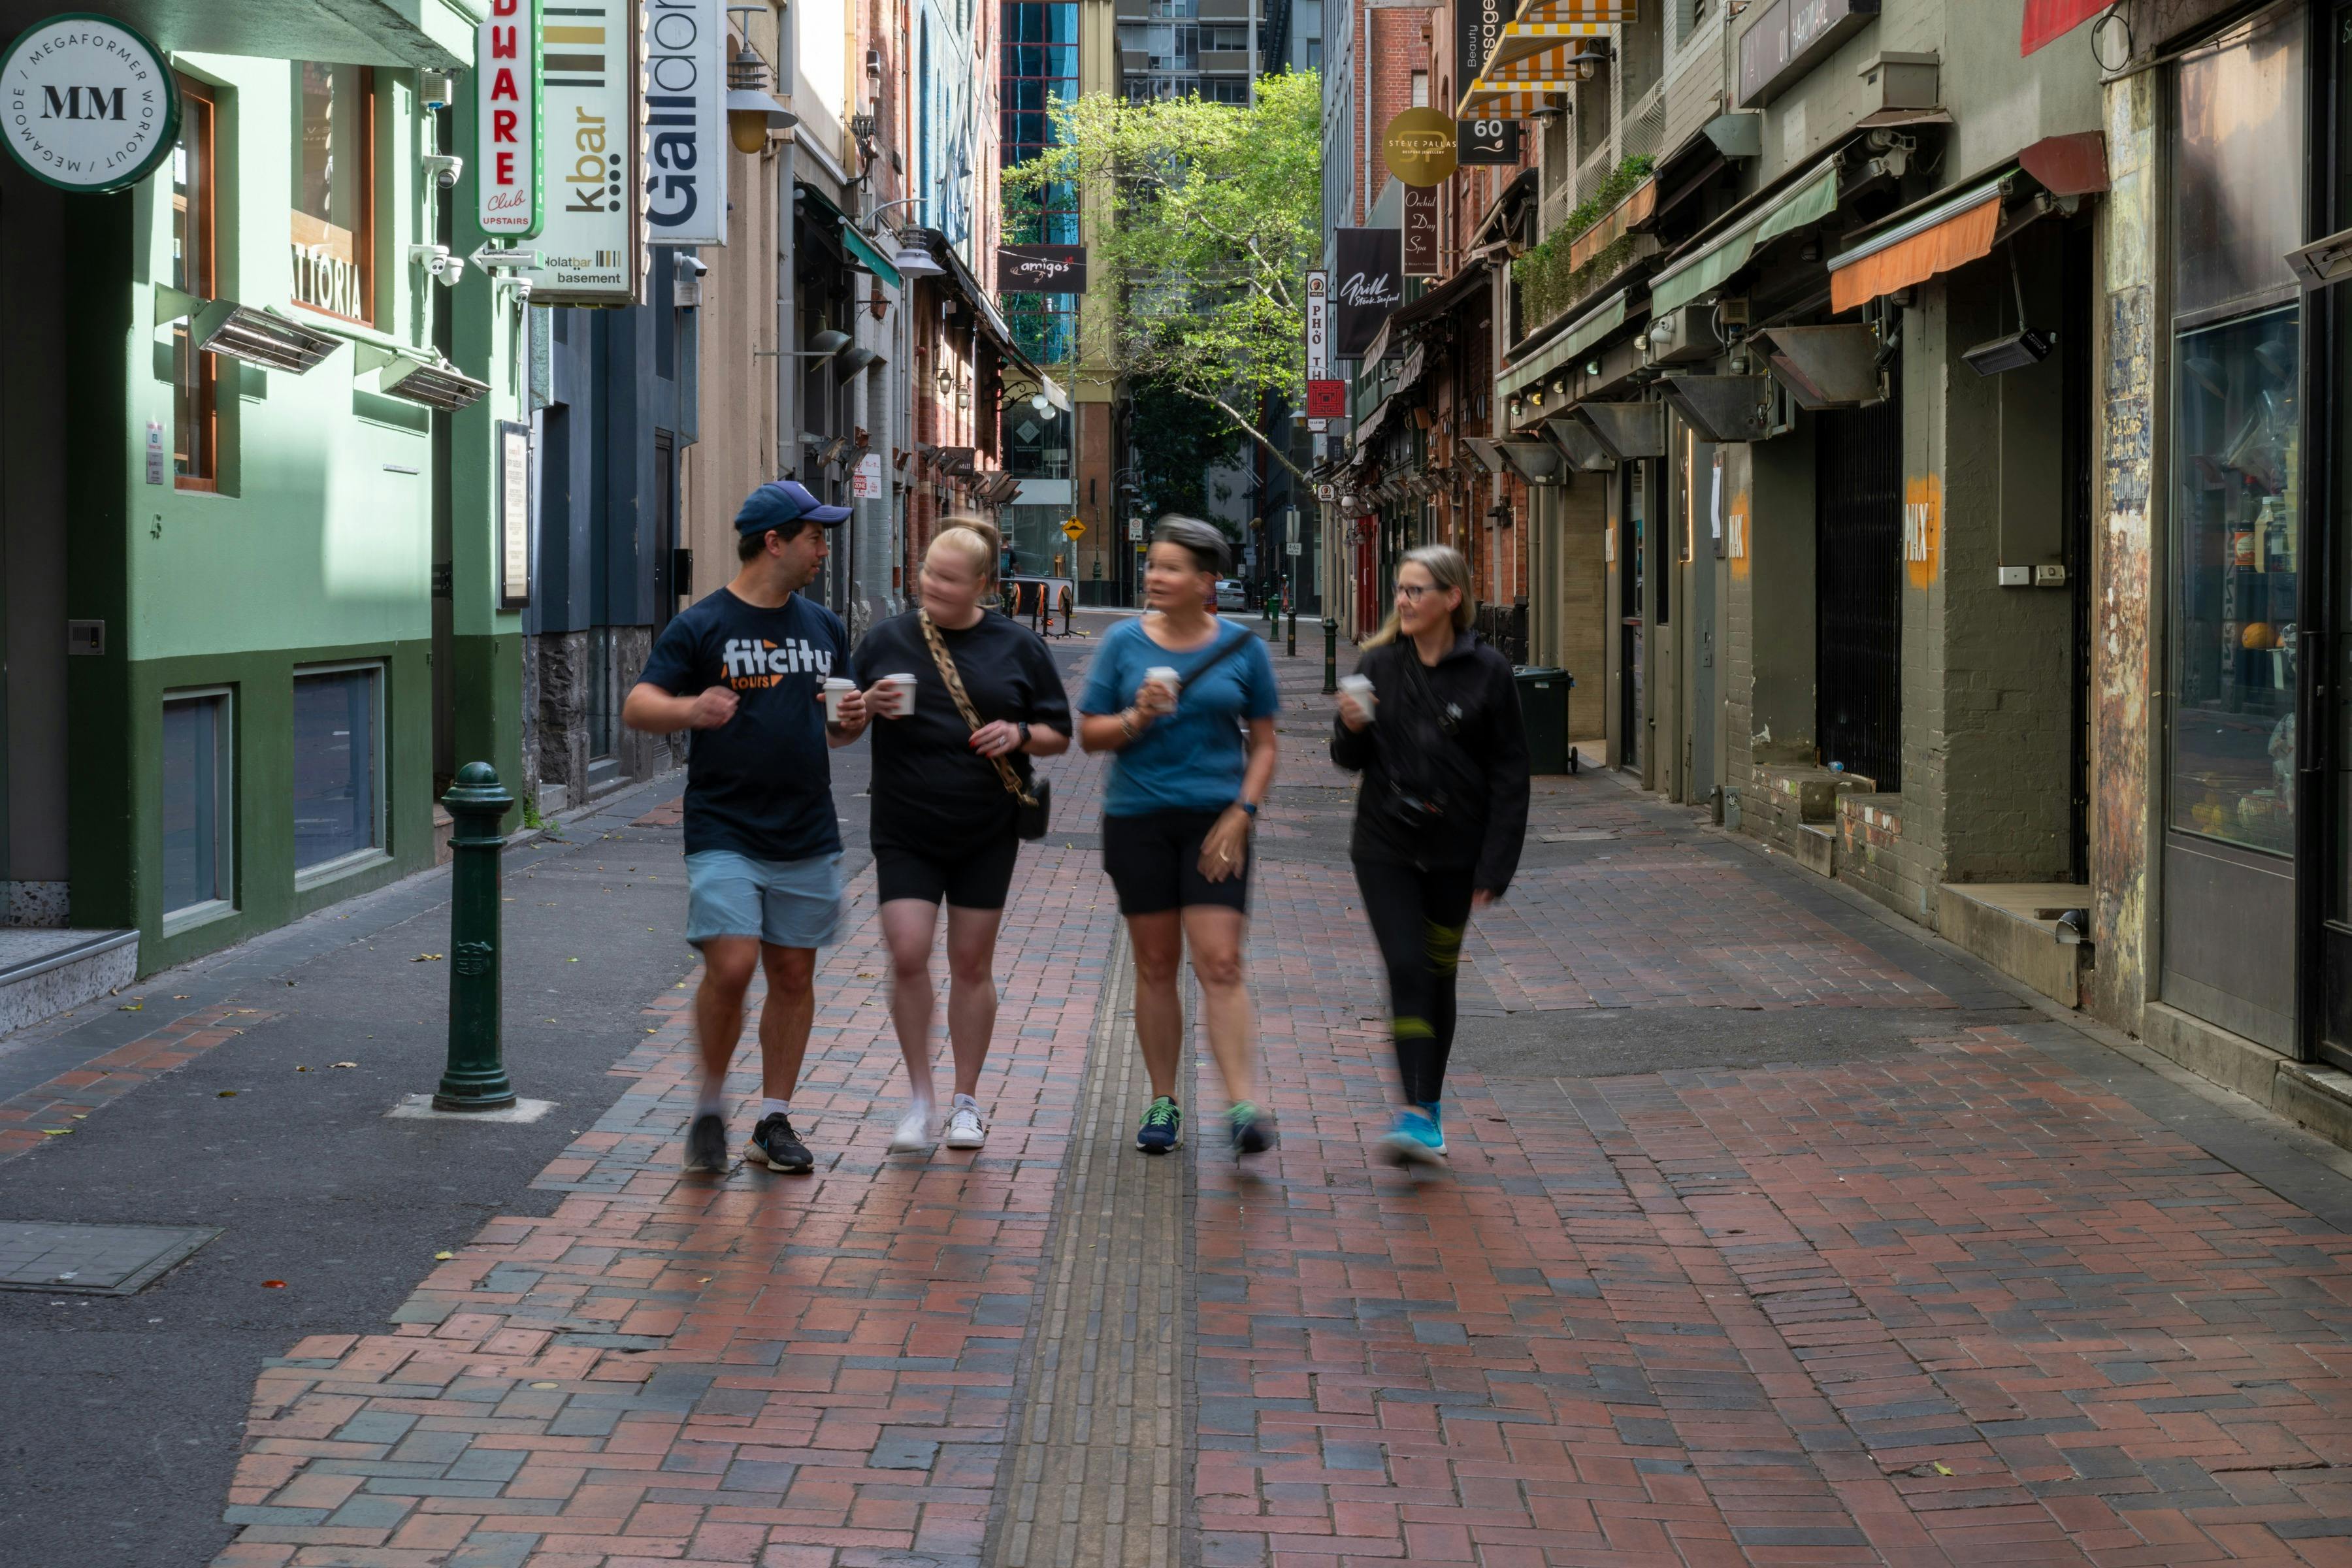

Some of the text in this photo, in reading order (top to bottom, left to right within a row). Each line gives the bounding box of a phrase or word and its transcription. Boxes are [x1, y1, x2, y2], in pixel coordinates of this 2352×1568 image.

[1467, 25, 1478, 67] Beauty
[29, 33, 154, 169] MEGAFORMER WORKOUT
[40, 84, 128, 121] MM
[12, 87, 80, 172] MEGAMODE
[1474, 120, 1503, 137] 60
[487, 189, 527, 211] Club
[1405, 191, 1437, 207] Orchid
[1411, 213, 1436, 233] Day
[1405, 235, 1426, 254] Spa
[557, 272, 621, 284] basement
[1021, 257, 1070, 278] amigos
[1340, 272, 1389, 306] Grill
[1354, 293, 1400, 308] Steak Seafood
[723, 638, 832, 685] fitcity
